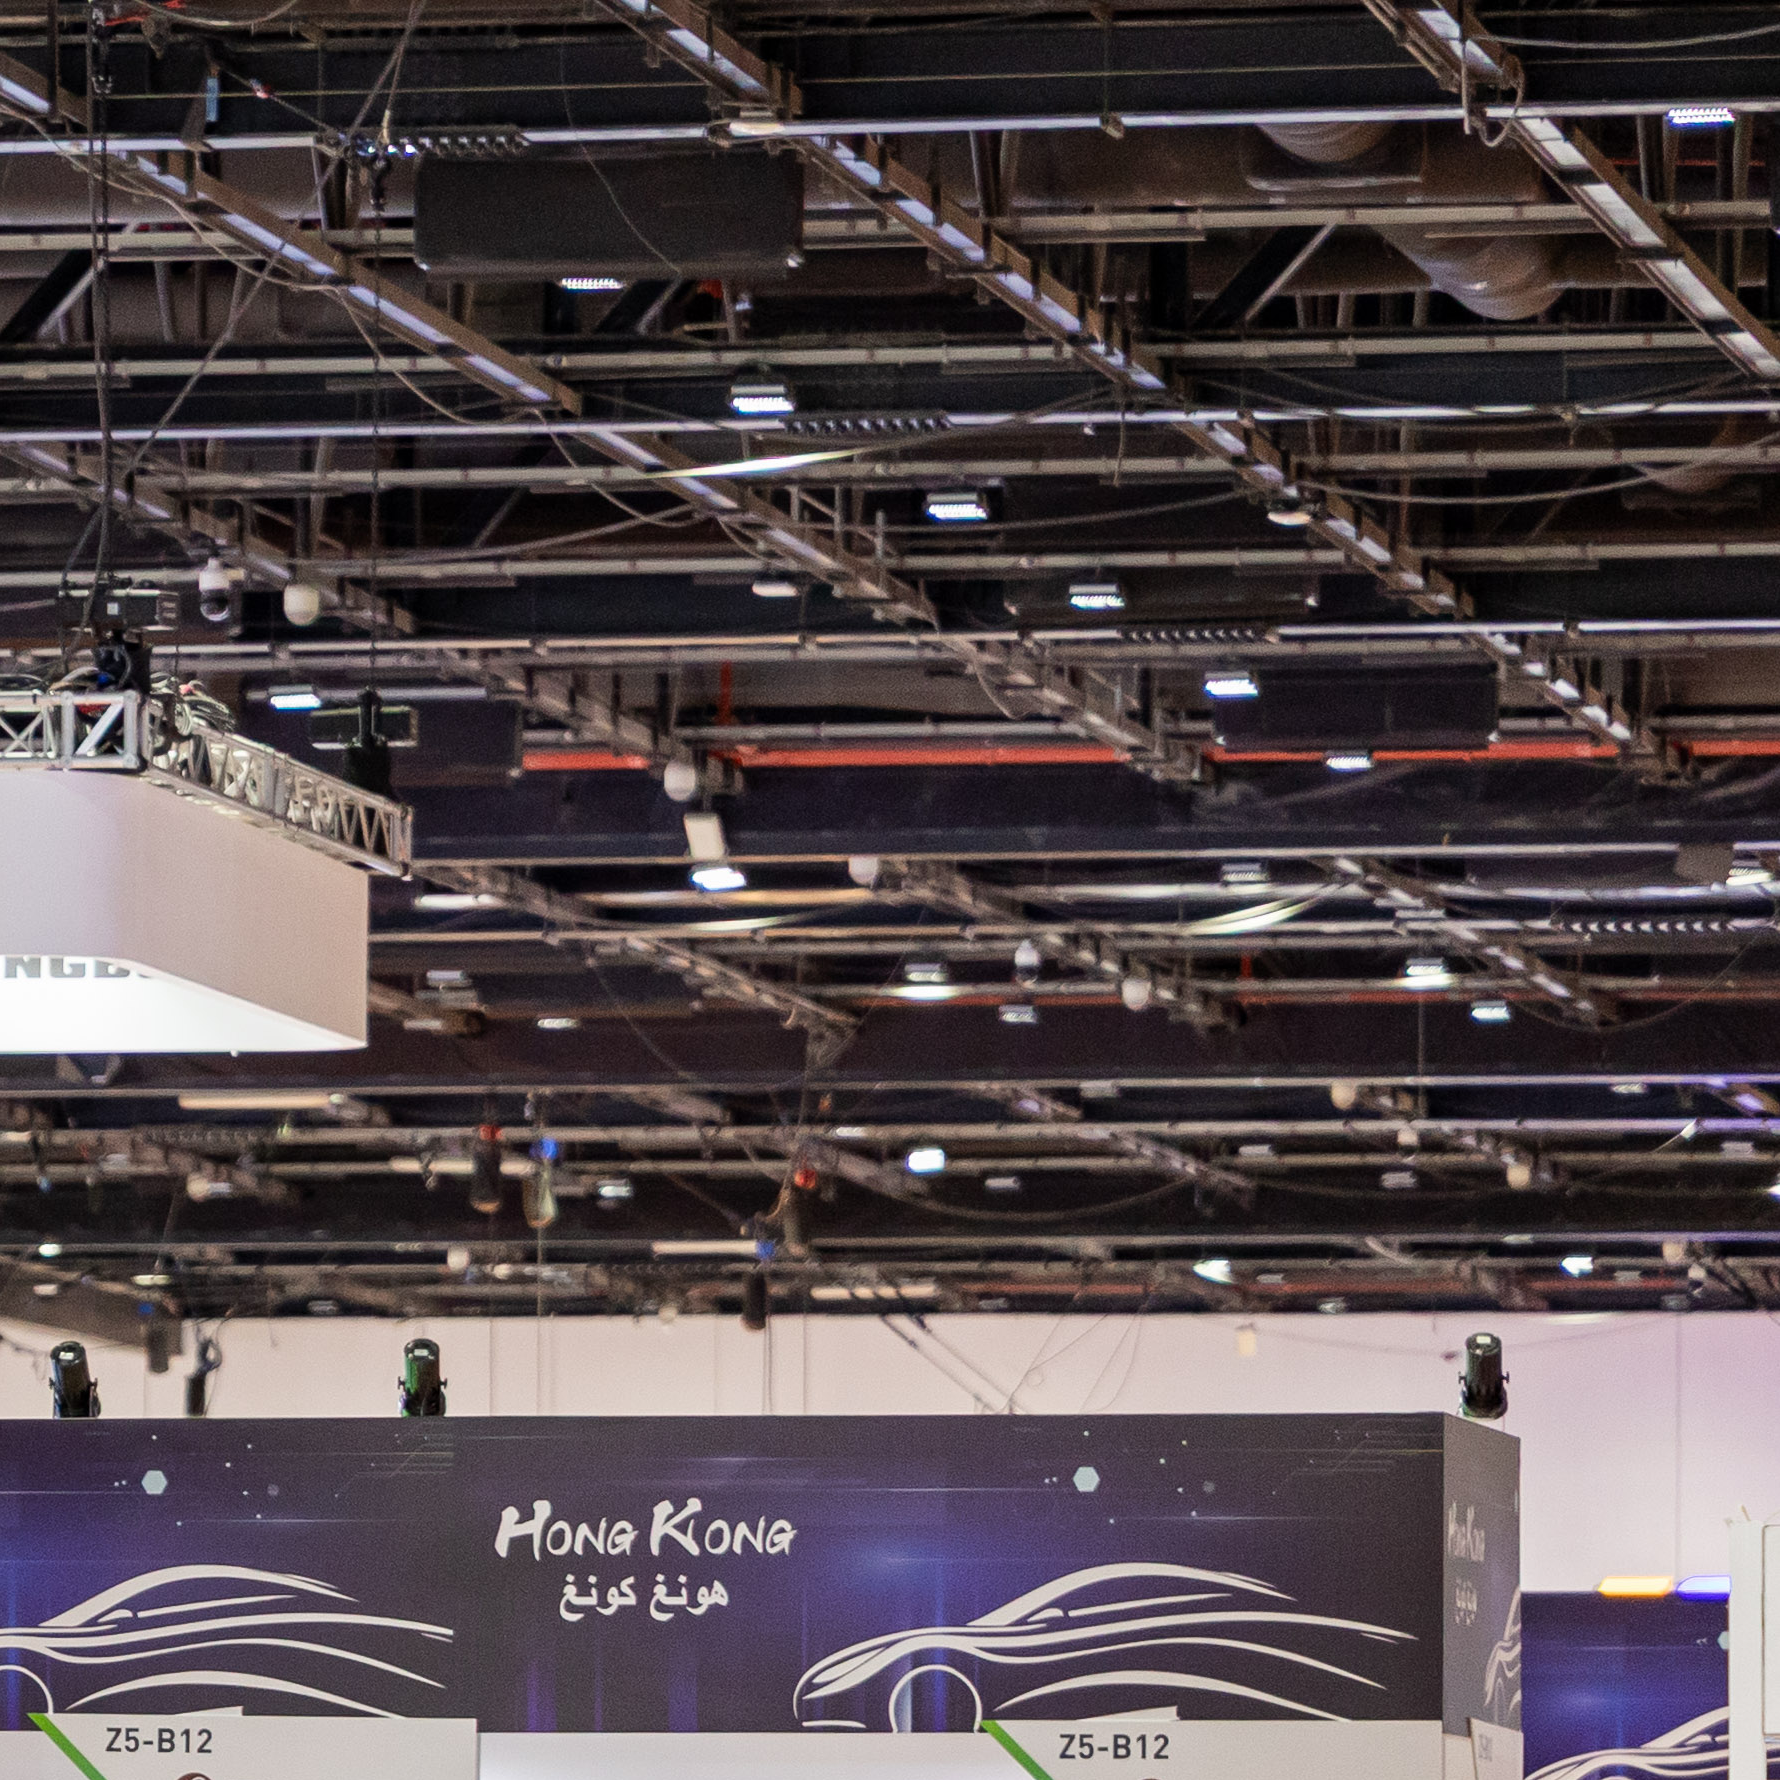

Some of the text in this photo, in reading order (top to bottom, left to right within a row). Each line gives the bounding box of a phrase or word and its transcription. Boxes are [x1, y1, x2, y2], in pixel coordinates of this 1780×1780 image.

[494, 1497, 797, 1561] HONG KONG
[559, 1573, 729, 1622] هونغ كونغ
[105, 1727, 213, 1754] Z5-B12
[1059, 1734, 1171, 1760] Z5-B12
